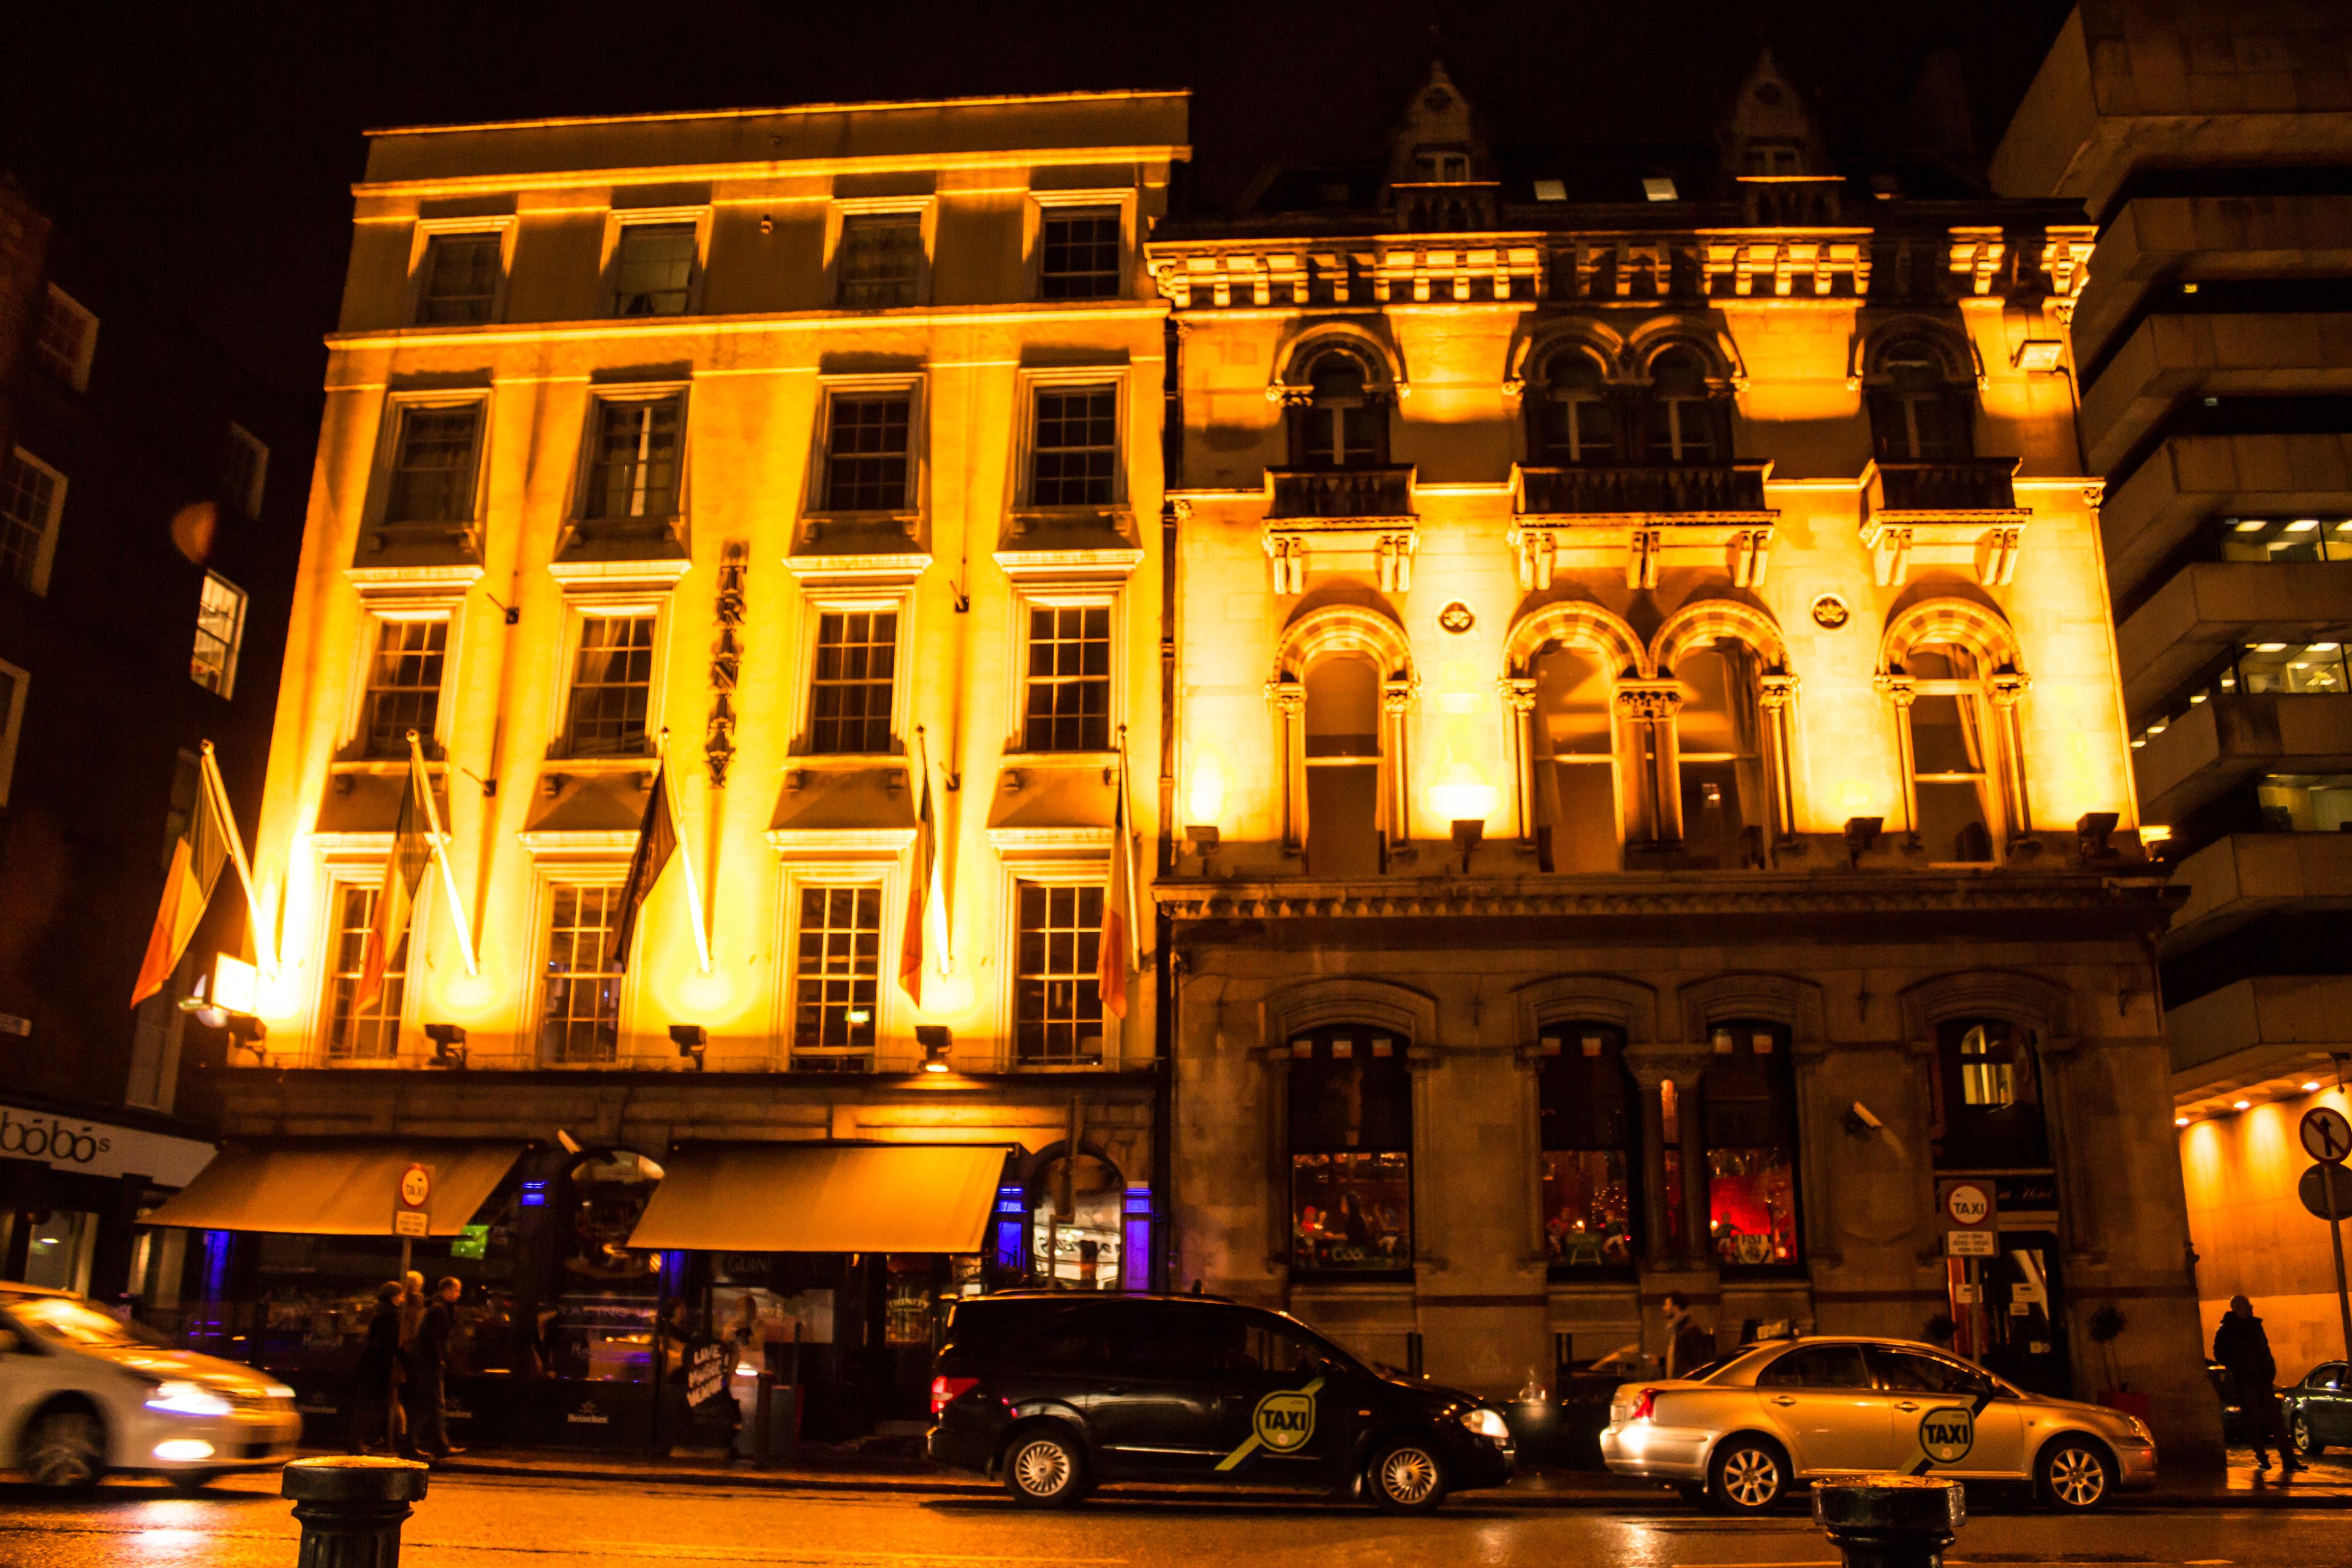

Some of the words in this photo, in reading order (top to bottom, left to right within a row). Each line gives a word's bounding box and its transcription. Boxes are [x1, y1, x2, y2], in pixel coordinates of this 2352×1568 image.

[1954, 1202, 1985, 1215] TAXI
[1262, 1410, 1306, 1430] TAXI
[1925, 1424, 1968, 1444] TAXI
